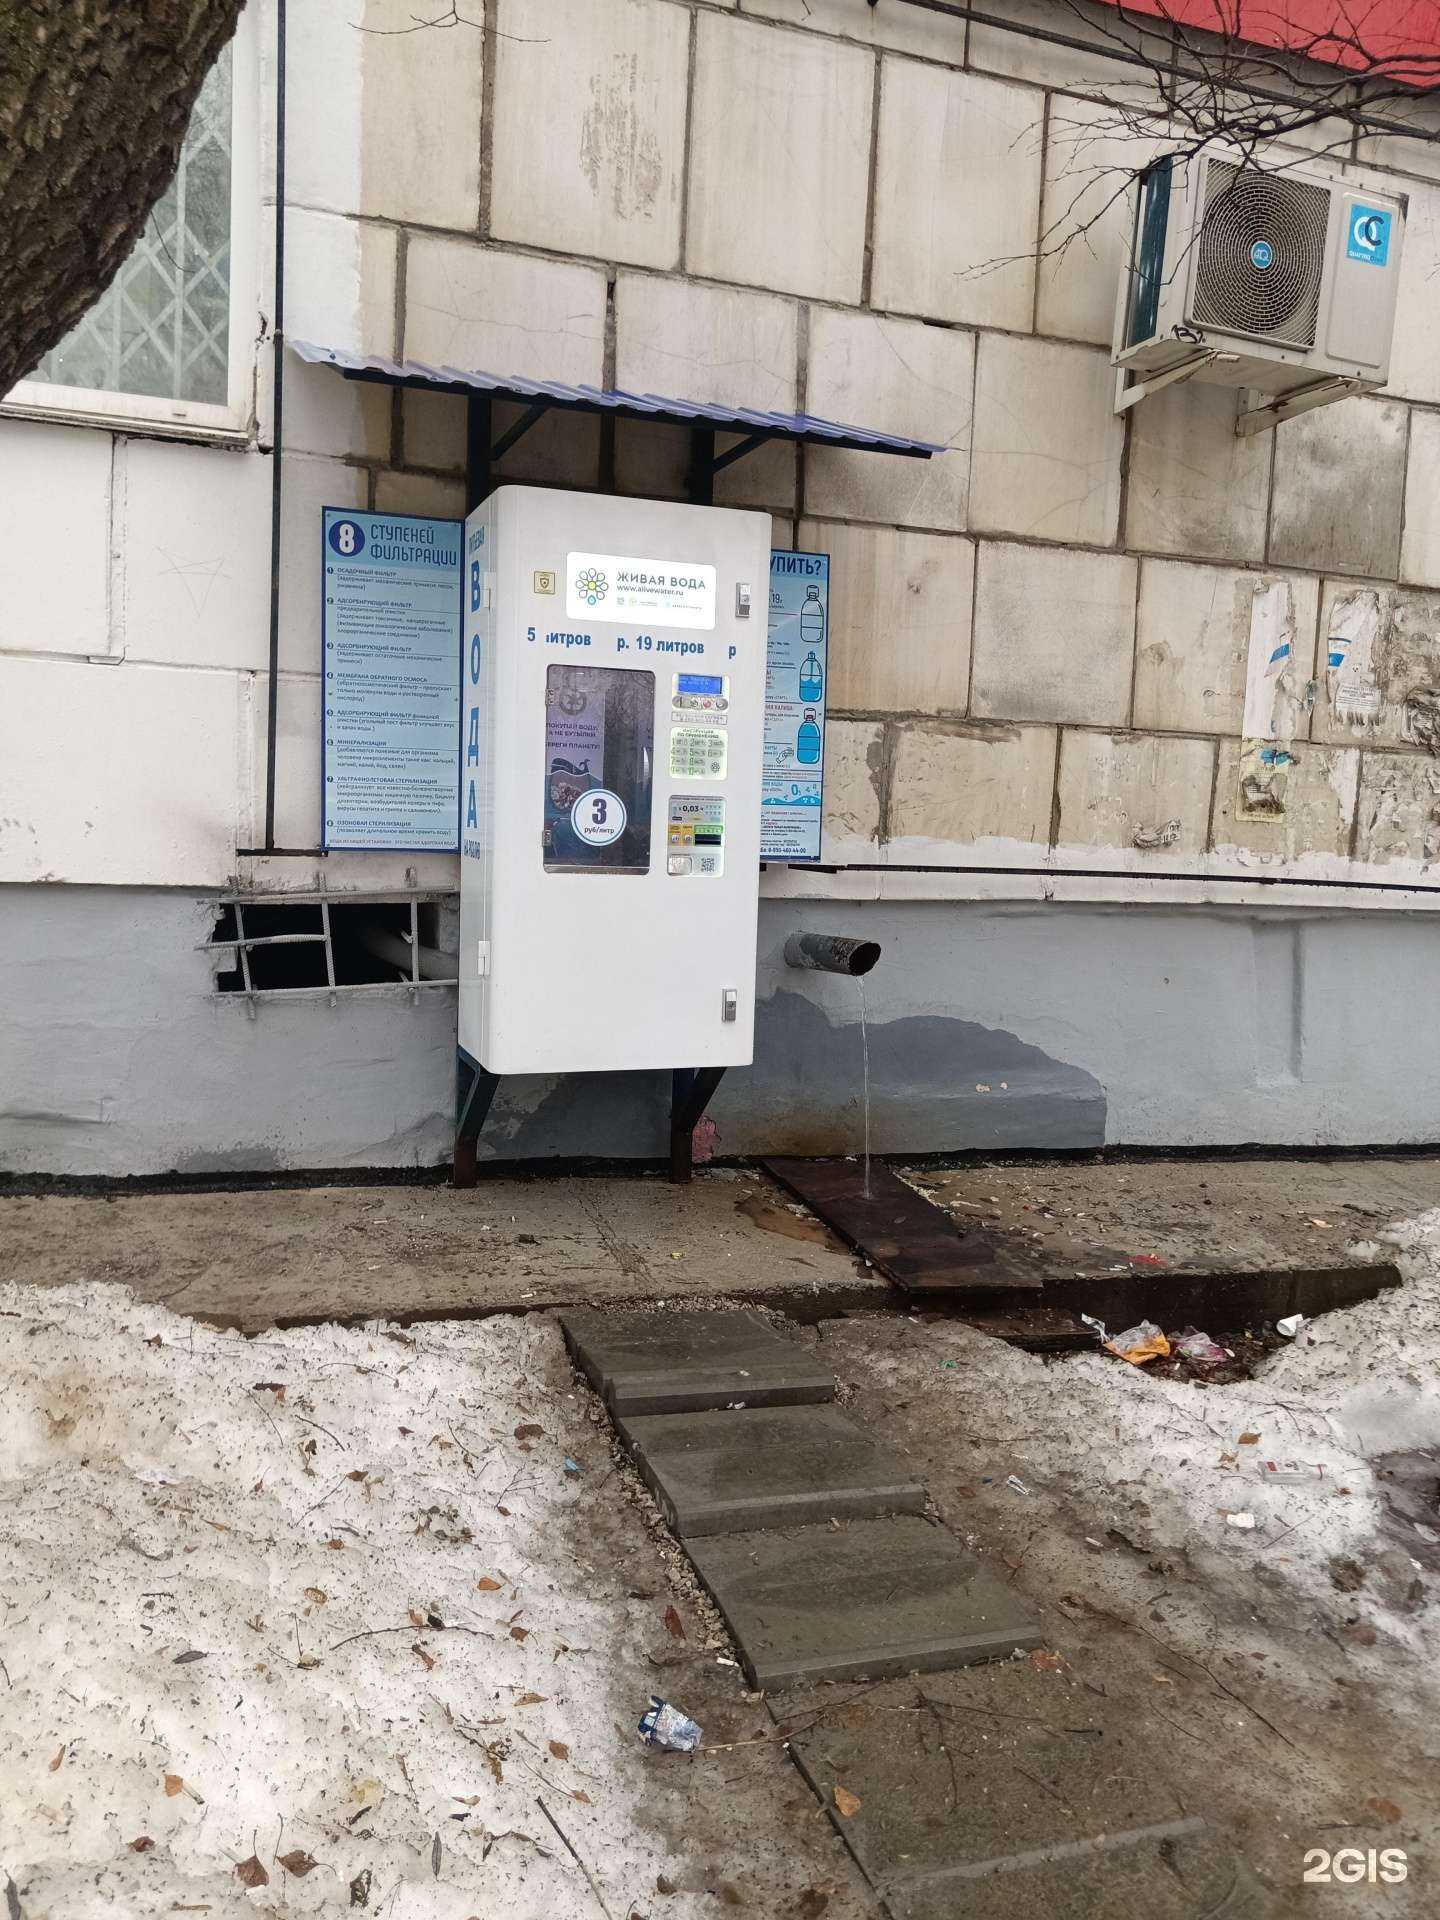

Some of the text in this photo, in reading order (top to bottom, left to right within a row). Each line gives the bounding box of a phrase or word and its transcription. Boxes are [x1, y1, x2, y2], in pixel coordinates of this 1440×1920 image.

[339, 524, 355, 554] 8
[370, 524, 434, 544] СТУПЕНЕЙ
[370, 544, 456, 566] ФИЛЬТРАЦИИ
[616, 584, 684, 596] www.alivewater.ru
[618, 572, 706, 590] ЖИВАЯ ВОДА
[527, 627, 536, 642] 5
[546, 632, 592, 648] итров
[636, 636, 652, 650] 19
[656, 640, 704, 656] литров
[468, 560, 481, 829] ВОДА
[592, 798, 607, 824] 3
[584, 826, 614, 834] руб/литр
